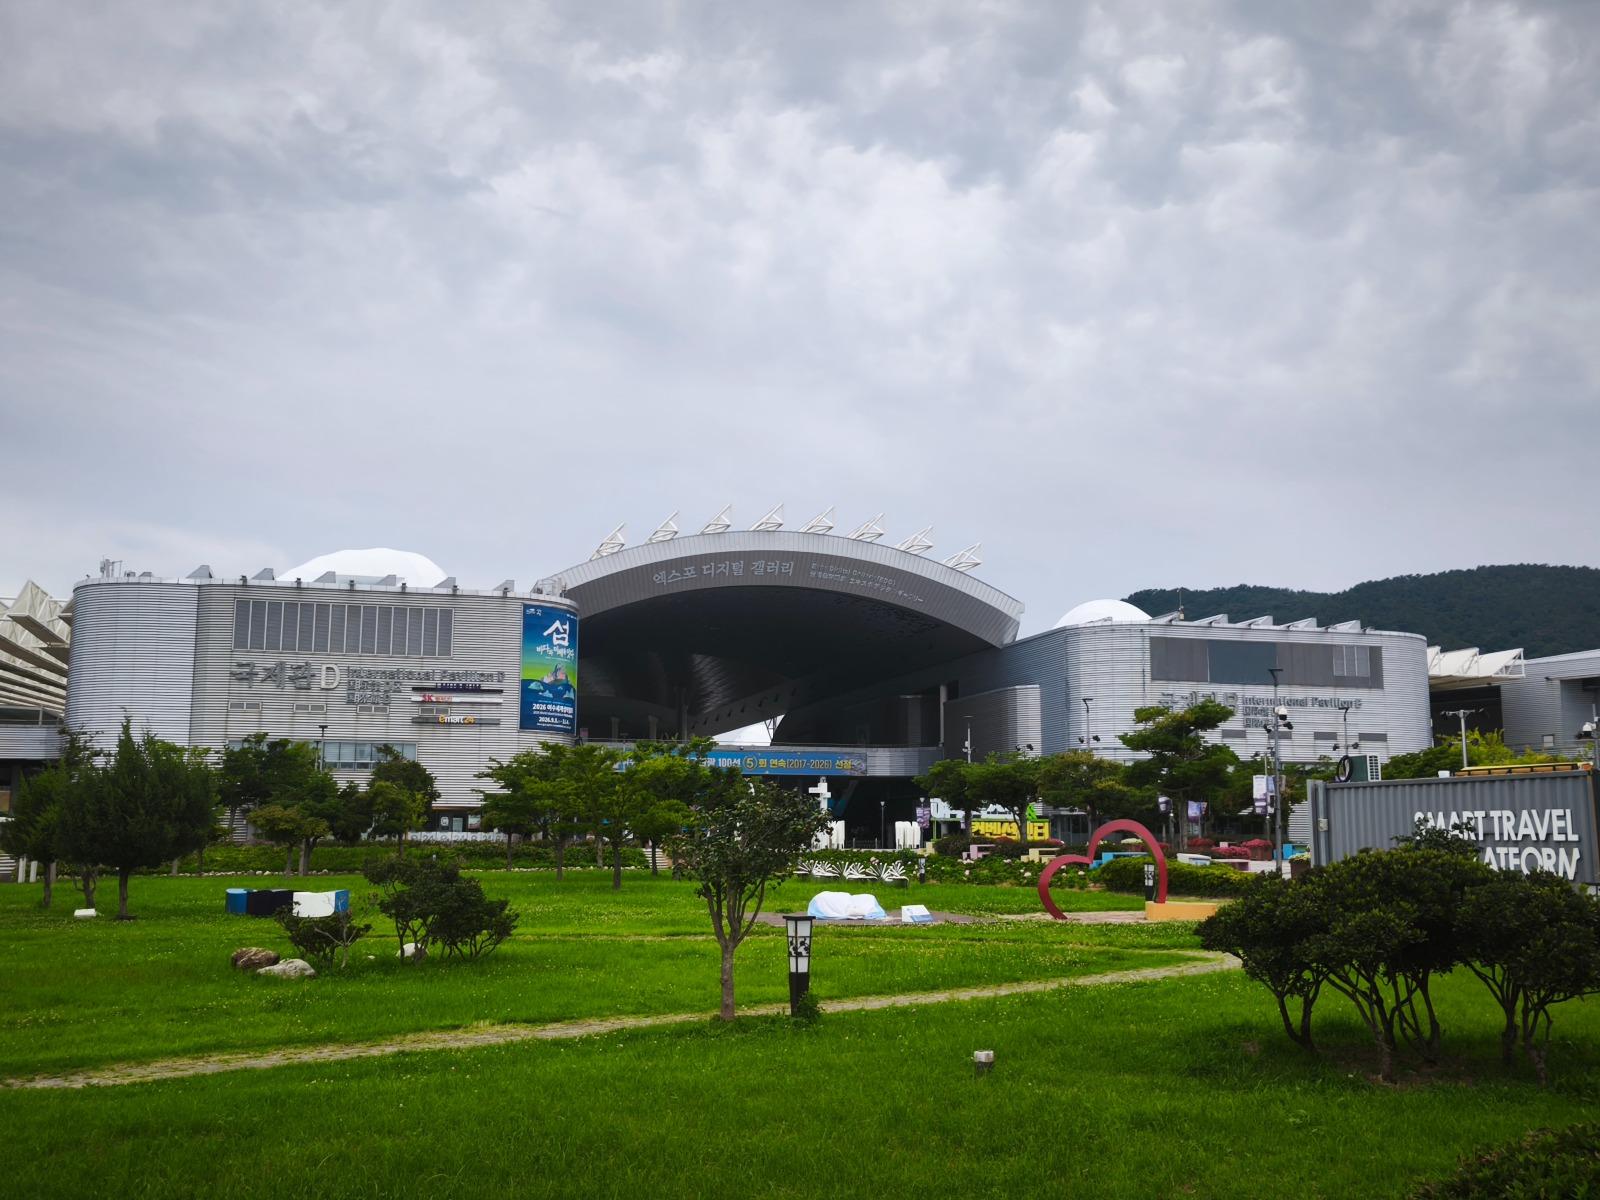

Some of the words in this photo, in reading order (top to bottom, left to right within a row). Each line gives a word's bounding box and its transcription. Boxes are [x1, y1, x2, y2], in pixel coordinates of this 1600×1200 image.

[652, 566, 697, 585] 엑스포
[702, 561, 744, 577] 디지털
[751, 560, 794, 576] 갤러리
[543, 620, 570, 646] 섬
[229, 661, 316, 691] 국제관
[320, 663, 341, 690] D
[347, 665, 436, 681] International
[439, 714, 475, 724] emart24
[1489, 808, 1579, 842] TRAVEL
